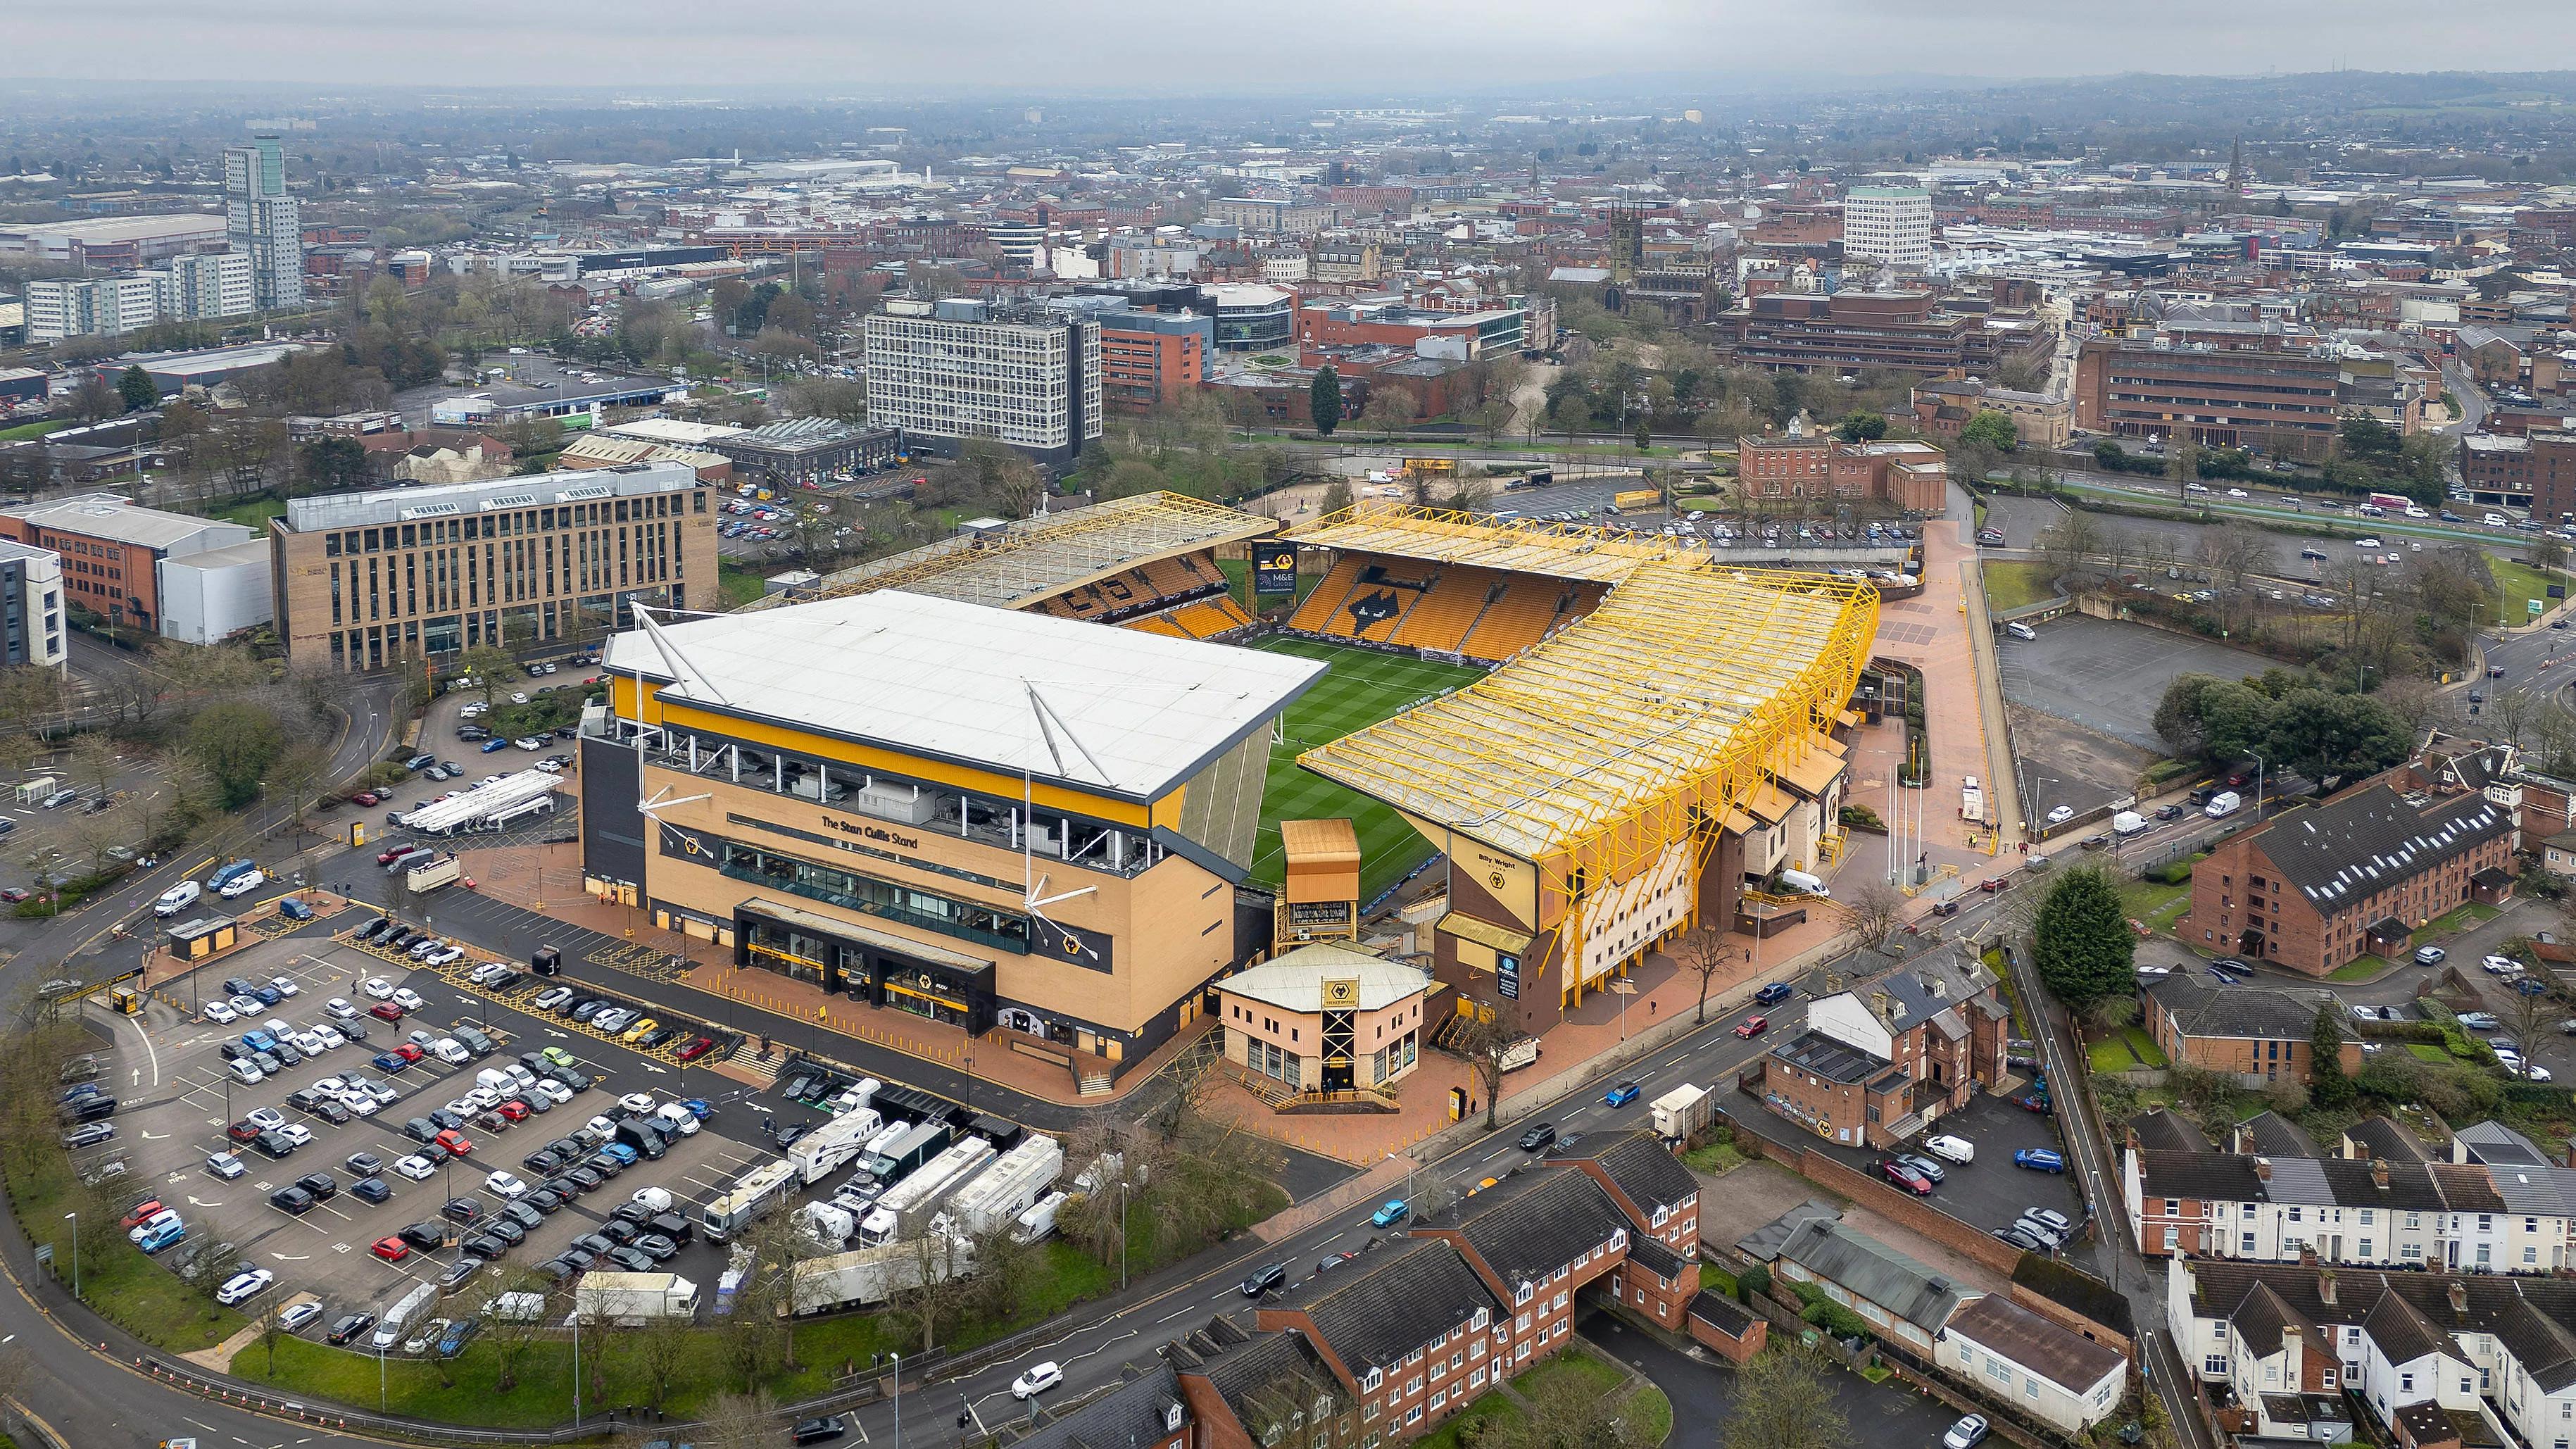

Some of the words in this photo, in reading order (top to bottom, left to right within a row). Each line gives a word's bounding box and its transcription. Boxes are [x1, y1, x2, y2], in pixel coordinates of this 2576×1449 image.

[1189, 586, 1206, 595] BYD
[1164, 592, 1181, 601] BYD
[1138, 599, 1156, 608] BYD
[1112, 607, 1130, 616] BYD
[822, 815, 838, 830] The
[840, 820, 862, 836] Stan
[864, 826, 890, 842] Cullis
[891, 833, 918, 849] Stand
[1478, 853, 1493, 864] Billy
[1494, 858, 1516, 870] Wright
[1498, 967, 1519, 978] PURCELL
[122, 1097, 146, 1106] EXIT
[1005, 1198, 1023, 1219] EMG
[332, 1241, 352, 1253] EXIT
